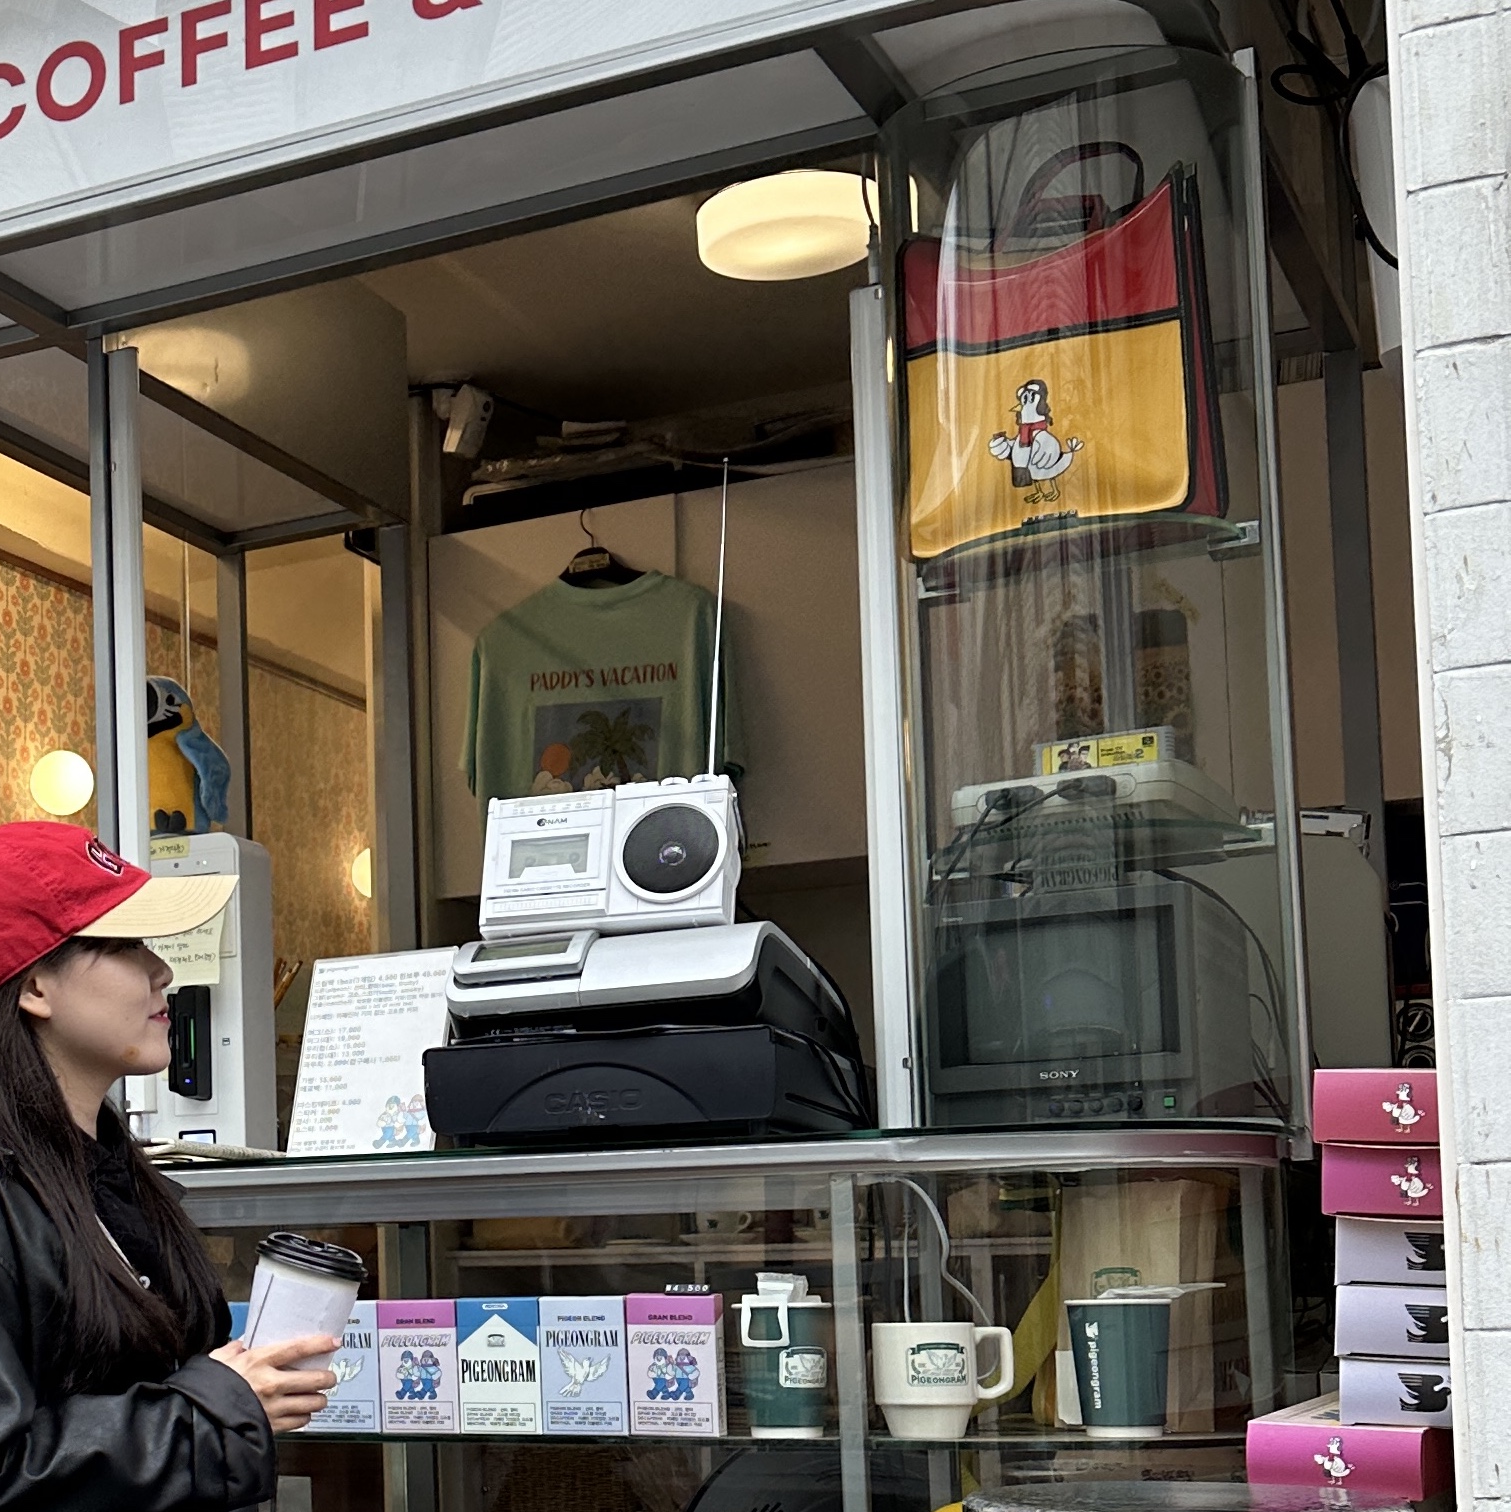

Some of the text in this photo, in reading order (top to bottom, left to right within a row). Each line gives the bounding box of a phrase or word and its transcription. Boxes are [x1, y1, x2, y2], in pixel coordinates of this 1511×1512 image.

[530, 662, 678, 692] PADDY'S VACATION
[1039, 1069, 1080, 1081] SONY
[544, 1088, 643, 1115] CASIO
[342, 1332, 372, 1349] GRAM
[545, 1329, 619, 1348] PIGEONGRAM
[630, 1330, 711, 1346] PIGEONGRAM
[461, 1358, 537, 1383] PIGEONGRAM
[1087, 1341, 1102, 1410] pigeongram
